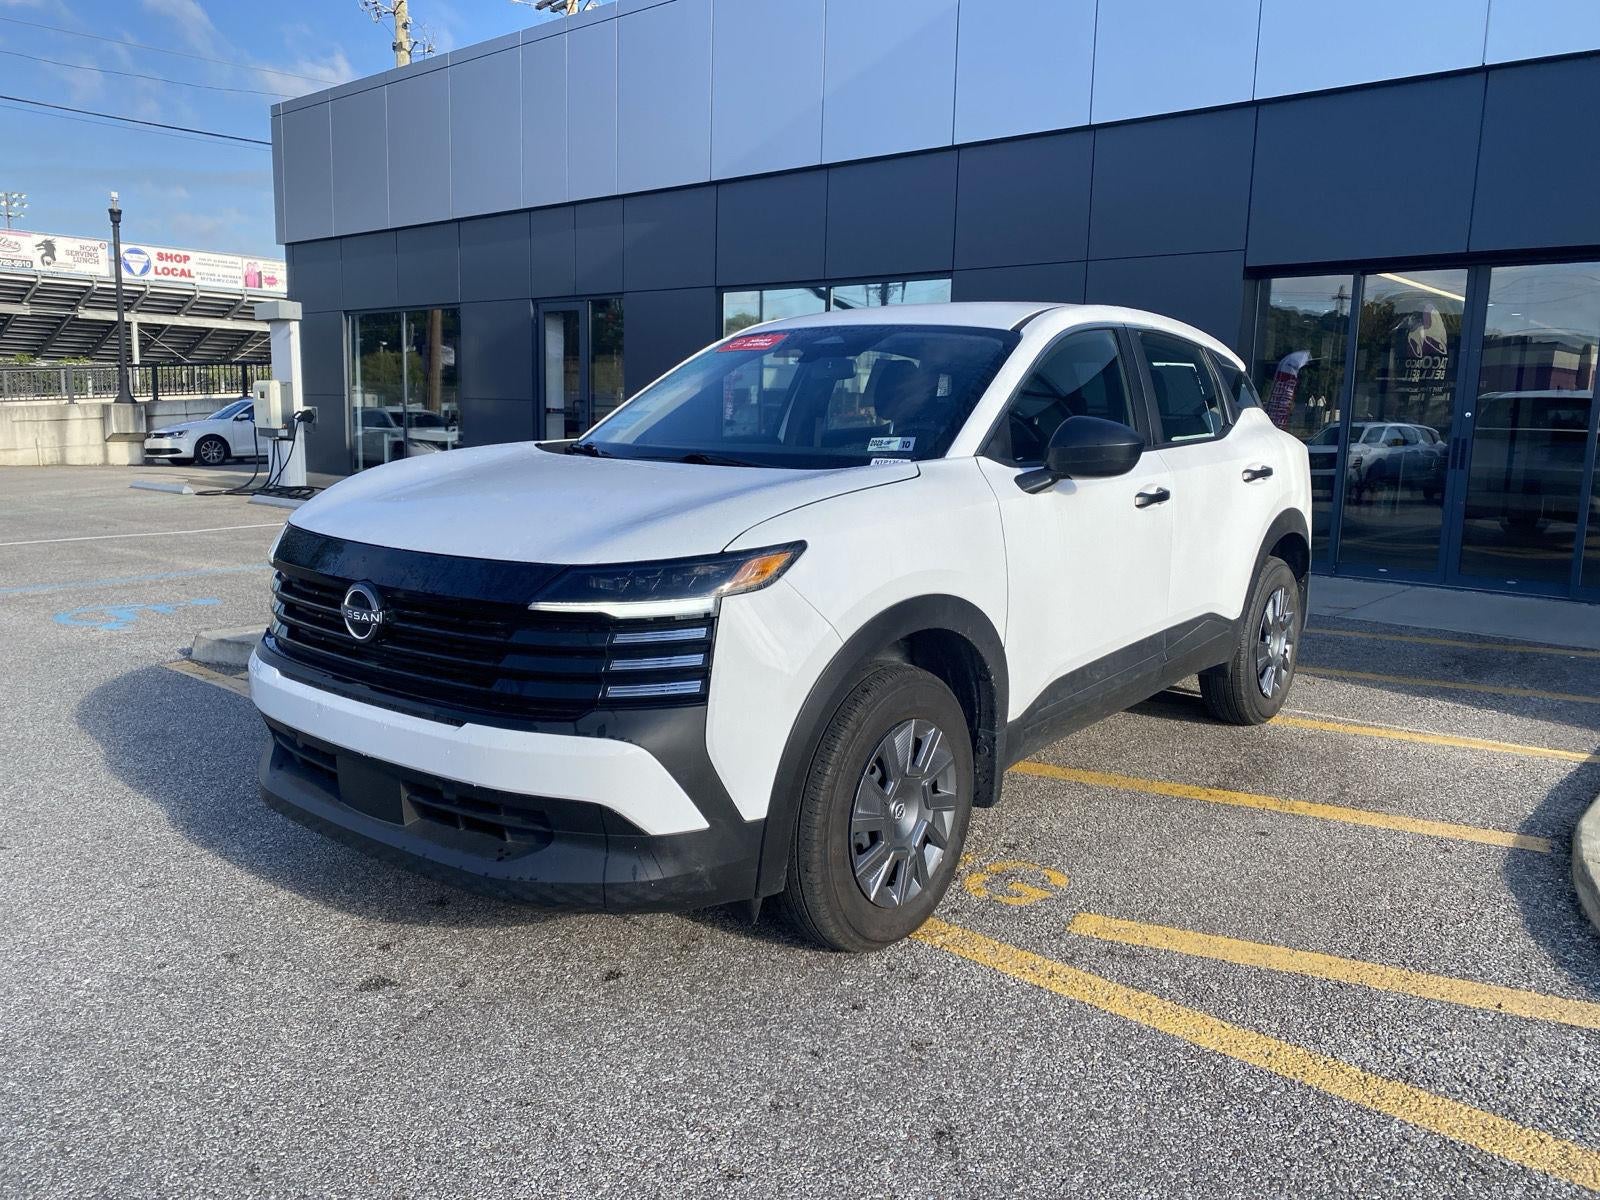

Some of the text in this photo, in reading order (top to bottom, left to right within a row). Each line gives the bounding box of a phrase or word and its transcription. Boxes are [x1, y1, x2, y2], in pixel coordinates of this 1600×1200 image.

[80, 244, 98, 252] NOW
[65, 249, 99, 258] SERVING
[157, 252, 191, 264] SHOP
[73, 256, 100, 265] LUNCH
[154, 266, 195, 278] LOCAL
[902, 440, 910, 449] 10
[347, 609, 380, 623] SSAN
